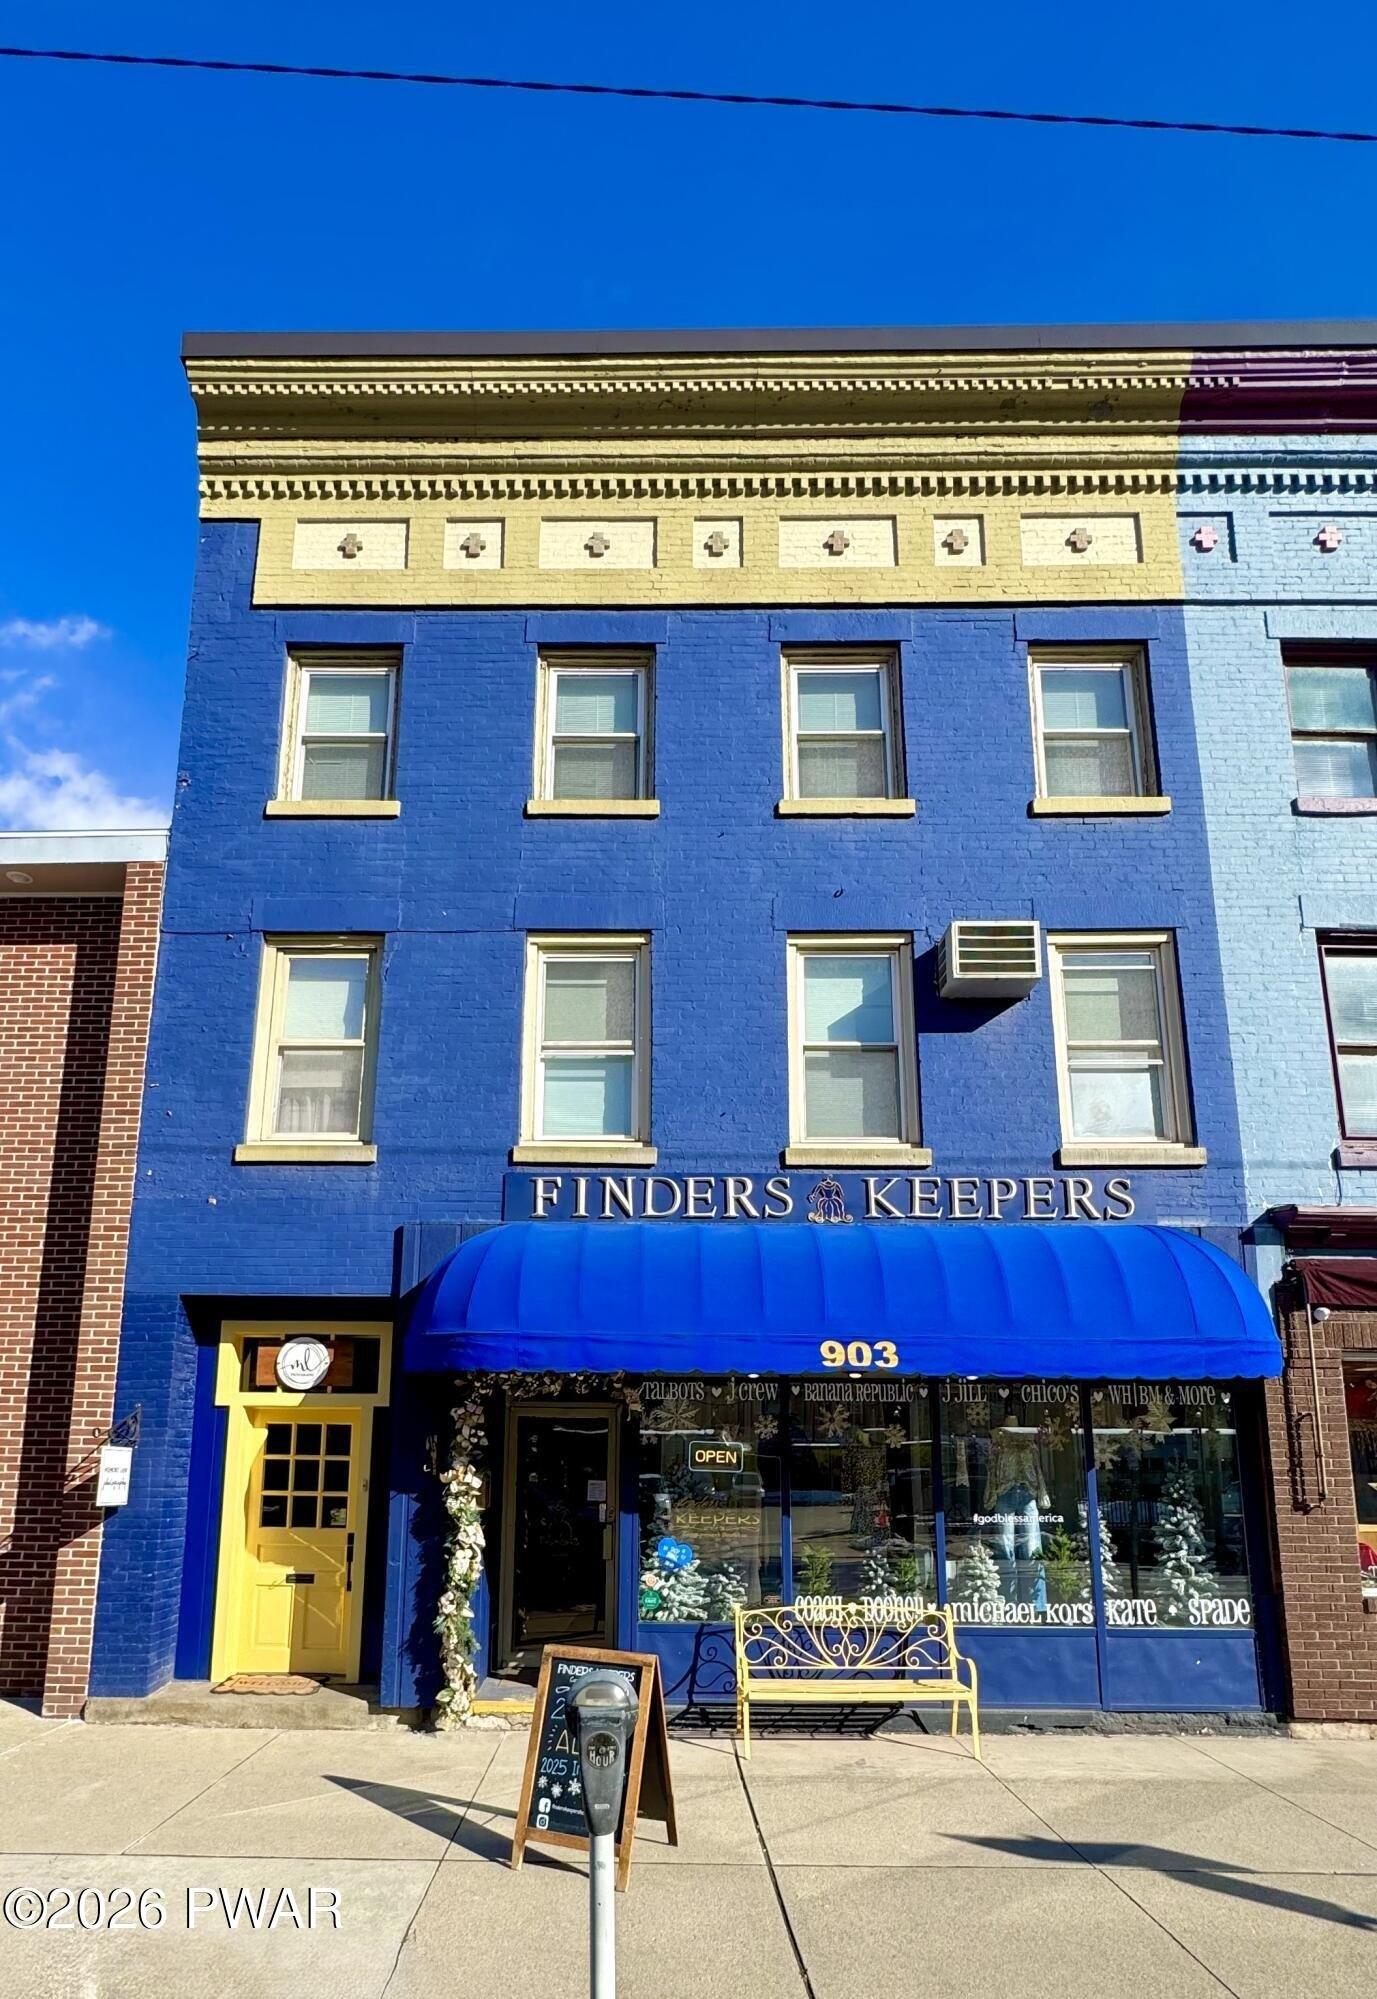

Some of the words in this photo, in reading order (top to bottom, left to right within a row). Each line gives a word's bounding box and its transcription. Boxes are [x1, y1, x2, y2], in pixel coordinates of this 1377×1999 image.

[530, 1175, 794, 1219] FINDERS
[862, 1176, 1136, 1221] KEEPERS
[820, 1340, 899, 1368] 903
[1164, 1385, 1176, 1406] &
[695, 1450, 738, 1464] OPEN
[973, 1513, 1064, 1525] #godblessamerica
[540, 1757, 568, 1776] 2025
[589, 1750, 615, 1767] HOUR
